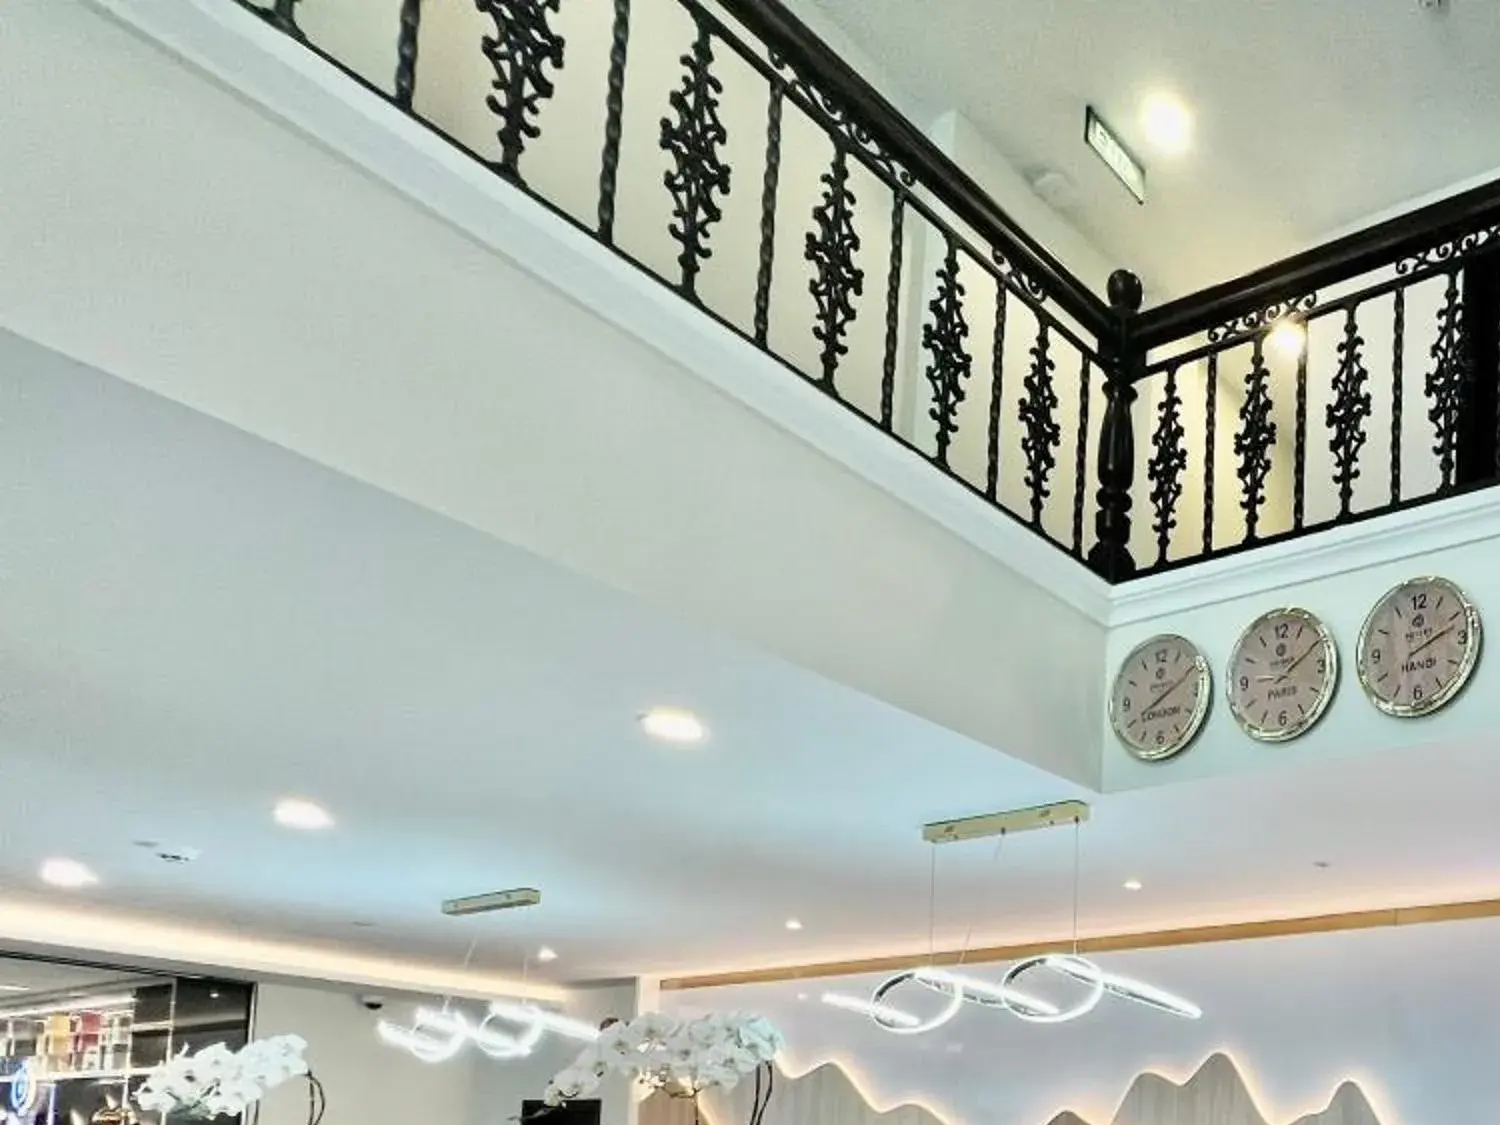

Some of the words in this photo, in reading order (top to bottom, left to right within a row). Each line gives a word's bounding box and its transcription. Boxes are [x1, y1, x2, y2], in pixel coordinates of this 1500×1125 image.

[1412, 594, 1427, 610] 12
[1274, 623, 1289, 639] 12
[1457, 630, 1467, 645] 3
[1154, 648, 1167, 662] 12
[1371, 649, 1381, 664] 9
[1317, 658, 1326, 673] 3
[1240, 676, 1249, 691] 9
[1267, 686, 1297, 700] PARIS
[1413, 685, 1423, 700] 6
[1123, 697, 1131, 712] 9
[1141, 706, 1181, 722] LONDON
[1278, 710, 1287, 726] 6
[1156, 730, 1165, 744] 6
